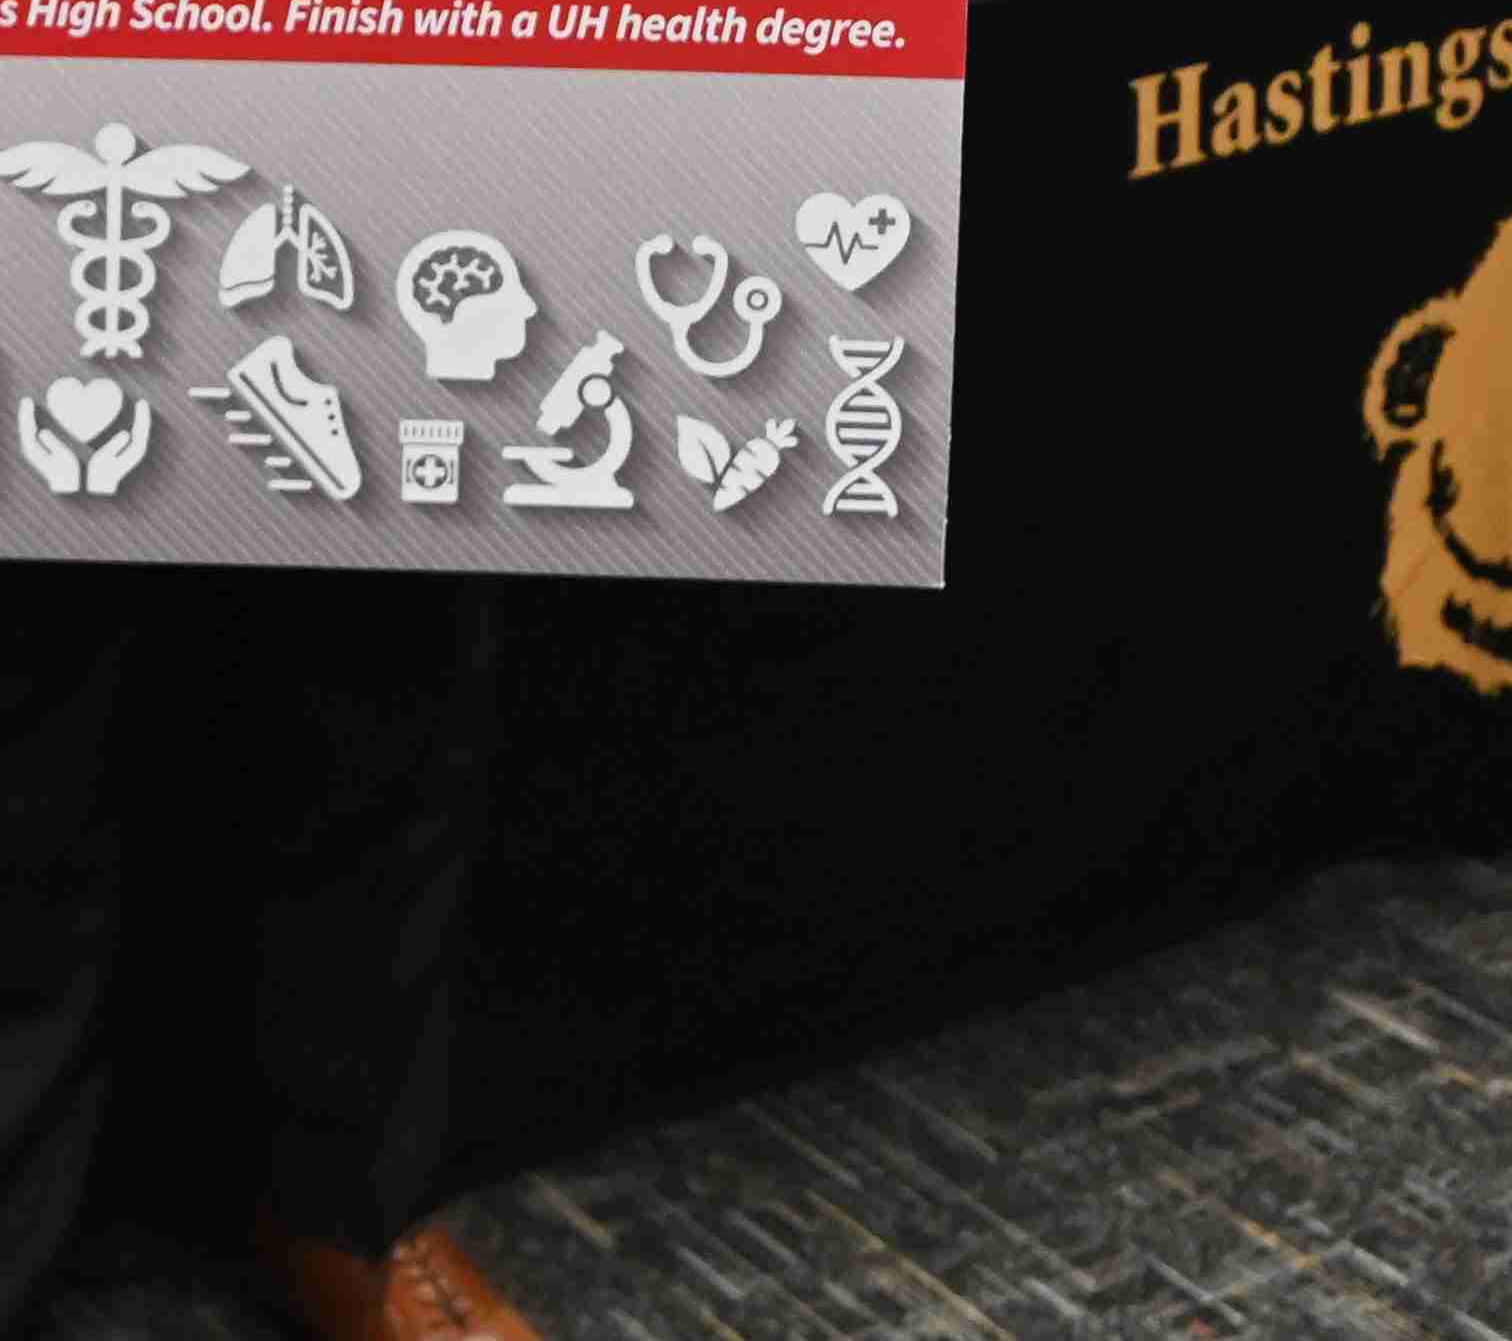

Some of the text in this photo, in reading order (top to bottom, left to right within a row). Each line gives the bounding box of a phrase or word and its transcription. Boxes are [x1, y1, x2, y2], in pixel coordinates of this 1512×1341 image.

[412, 0, 503, 40] with
[511, 10, 537, 40] a
[547, 3, 610, 42] UH
[615, 2, 748, 45] health
[754, 6, 907, 57] degree.
